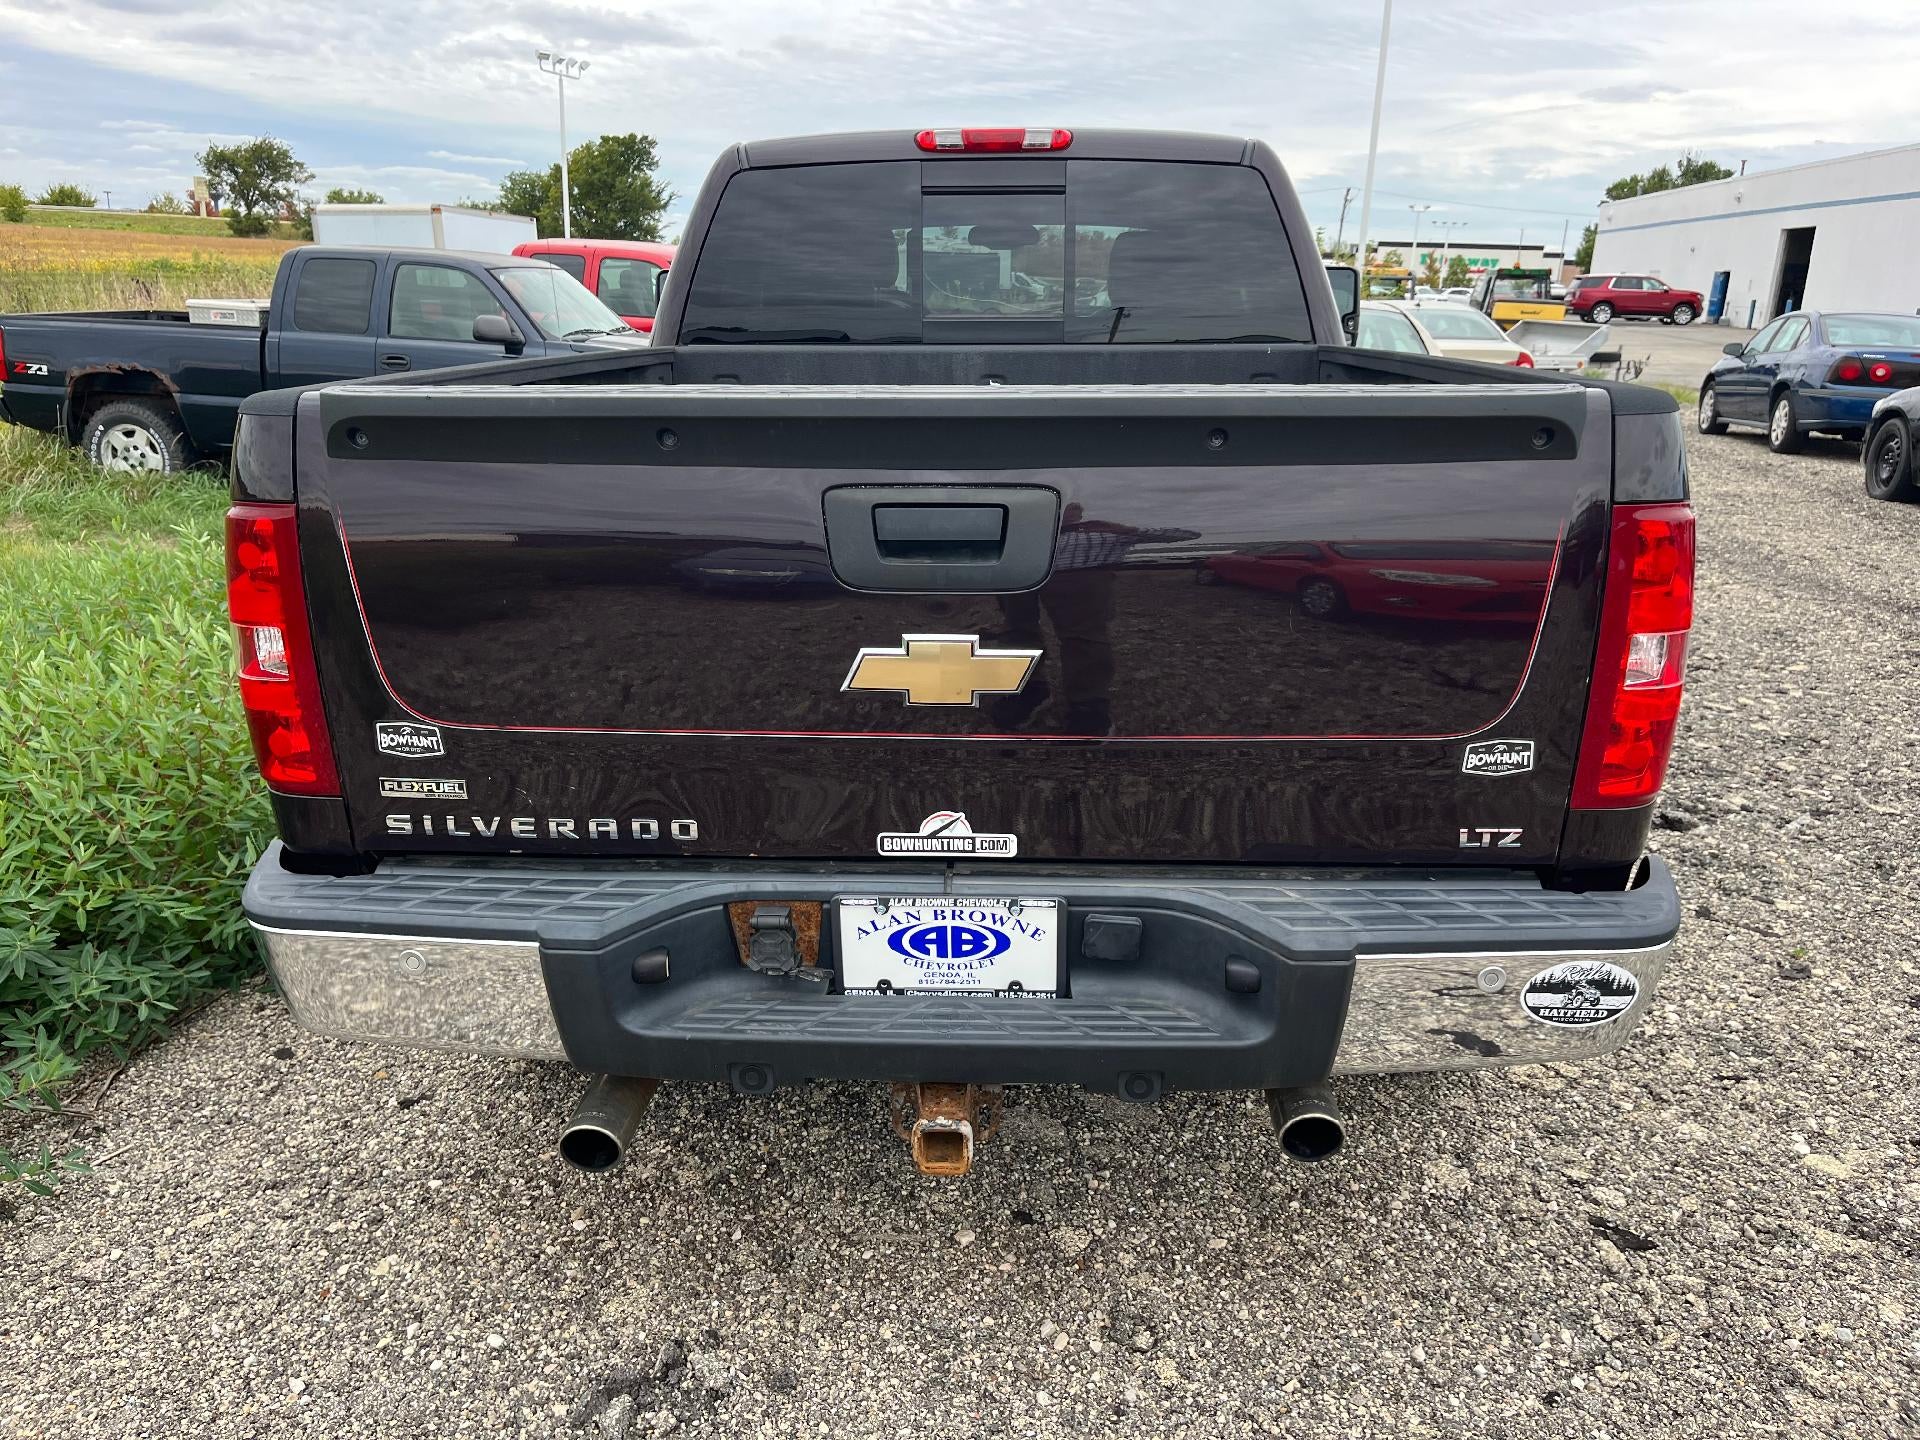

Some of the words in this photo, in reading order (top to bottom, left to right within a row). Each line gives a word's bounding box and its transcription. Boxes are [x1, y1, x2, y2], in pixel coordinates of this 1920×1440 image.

[14, 362, 48, 374] Z71
[381, 733, 438, 750] BOWHUNT
[1467, 752, 1531, 769] BOWHUNT
[383, 781, 464, 793] FLEXFUEL
[385, 814, 699, 840] SILVERADO
[1459, 828, 1523, 848] LTZ
[888, 898, 912, 907] ALAN
[915, 898, 955, 907] BROWNE
[956, 899, 1012, 908] CHEVROLET
[857, 909, 921, 941] ALAN
[933, 909, 1046, 943] BROWNE
[908, 925, 990, 959] AB
[903, 957, 996, 971] CHEVROLET
[923, 971, 964, 979] GENOA,
[967, 971, 977, 979] IL
[998, 991, 1056, 999] 815-784-2511
[1539, 1009, 1608, 1018] HATFIELD
